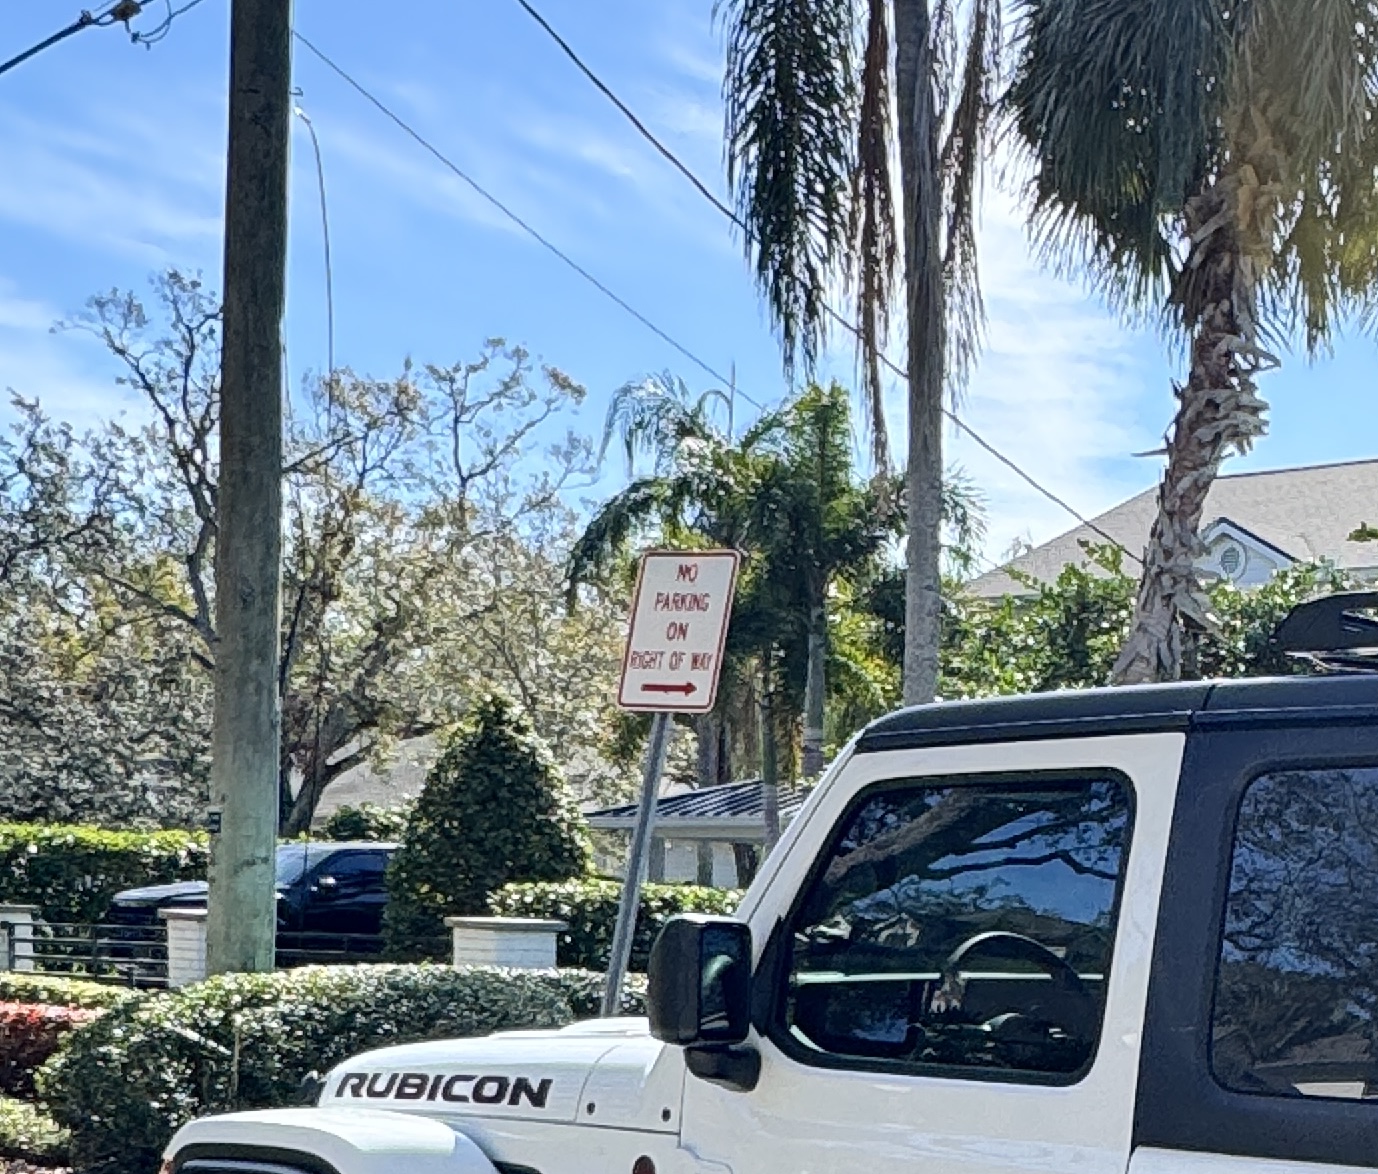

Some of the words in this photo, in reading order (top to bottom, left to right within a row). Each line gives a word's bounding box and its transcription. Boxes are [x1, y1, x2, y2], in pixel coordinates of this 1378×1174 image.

[675, 563, 698, 582] NO
[654, 592, 711, 612] PARKING
[666, 622, 689, 641] ON
[630, 651, 665, 670] RIGHT
[669, 651, 686, 671] OF
[690, 652, 713, 671] WAY
[334, 1072, 554, 1109] RUBICON
